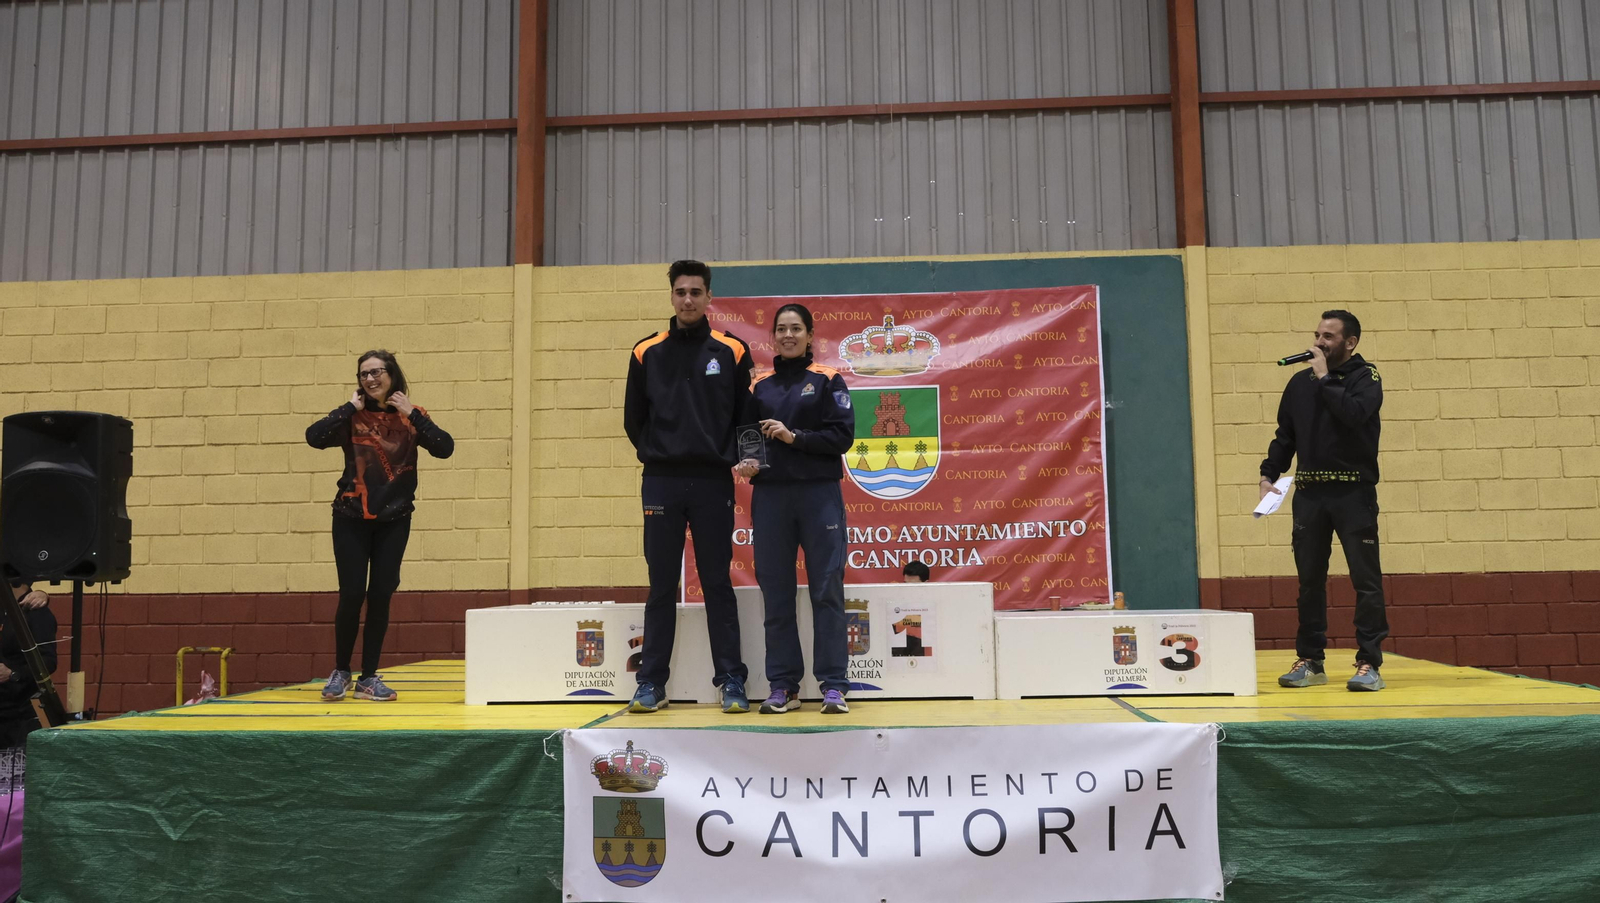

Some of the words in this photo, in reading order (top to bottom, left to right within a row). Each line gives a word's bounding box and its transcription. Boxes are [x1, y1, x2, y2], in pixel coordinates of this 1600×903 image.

[812, 311, 872, 321] CANTORIA
[941, 306, 1001, 317] CANTORIA
[707, 313, 745, 322] TORIA
[1007, 387, 1070, 398] CANTORIA
[944, 413, 1005, 425] CANTORIA
[1010, 442, 1071, 453] CANTORIA
[945, 469, 1007, 480] CANTORIA
[881, 501, 943, 512] CANTORIA
[1012, 497, 1074, 509] CANTORIA
[897, 519, 1087, 543] AYUNTAMIENTO
[847, 547, 983, 569] CANTORIA
[1014, 553, 1076, 565] CANTORIA
[892, 615, 932, 656] 1
[1159, 633, 1201, 671] 3
[848, 658, 883, 668] ACIÓN
[564, 670, 615, 680] DIPUTACIÓN
[846, 669, 881, 679] LMERÍA
[1104, 667, 1148, 676] DIPUTACIÓN
[566, 680, 577, 688] DE
[579, 679, 615, 688] ALMERÍA
[1106, 675, 1116, 683] DE
[1117, 674, 1147, 683] ALMERÍA
[701, 771, 1097, 799] AYUNTAMIENTO
[1125, 768, 1173, 792] DE
[696, 803, 1186, 858] CANTORIA
